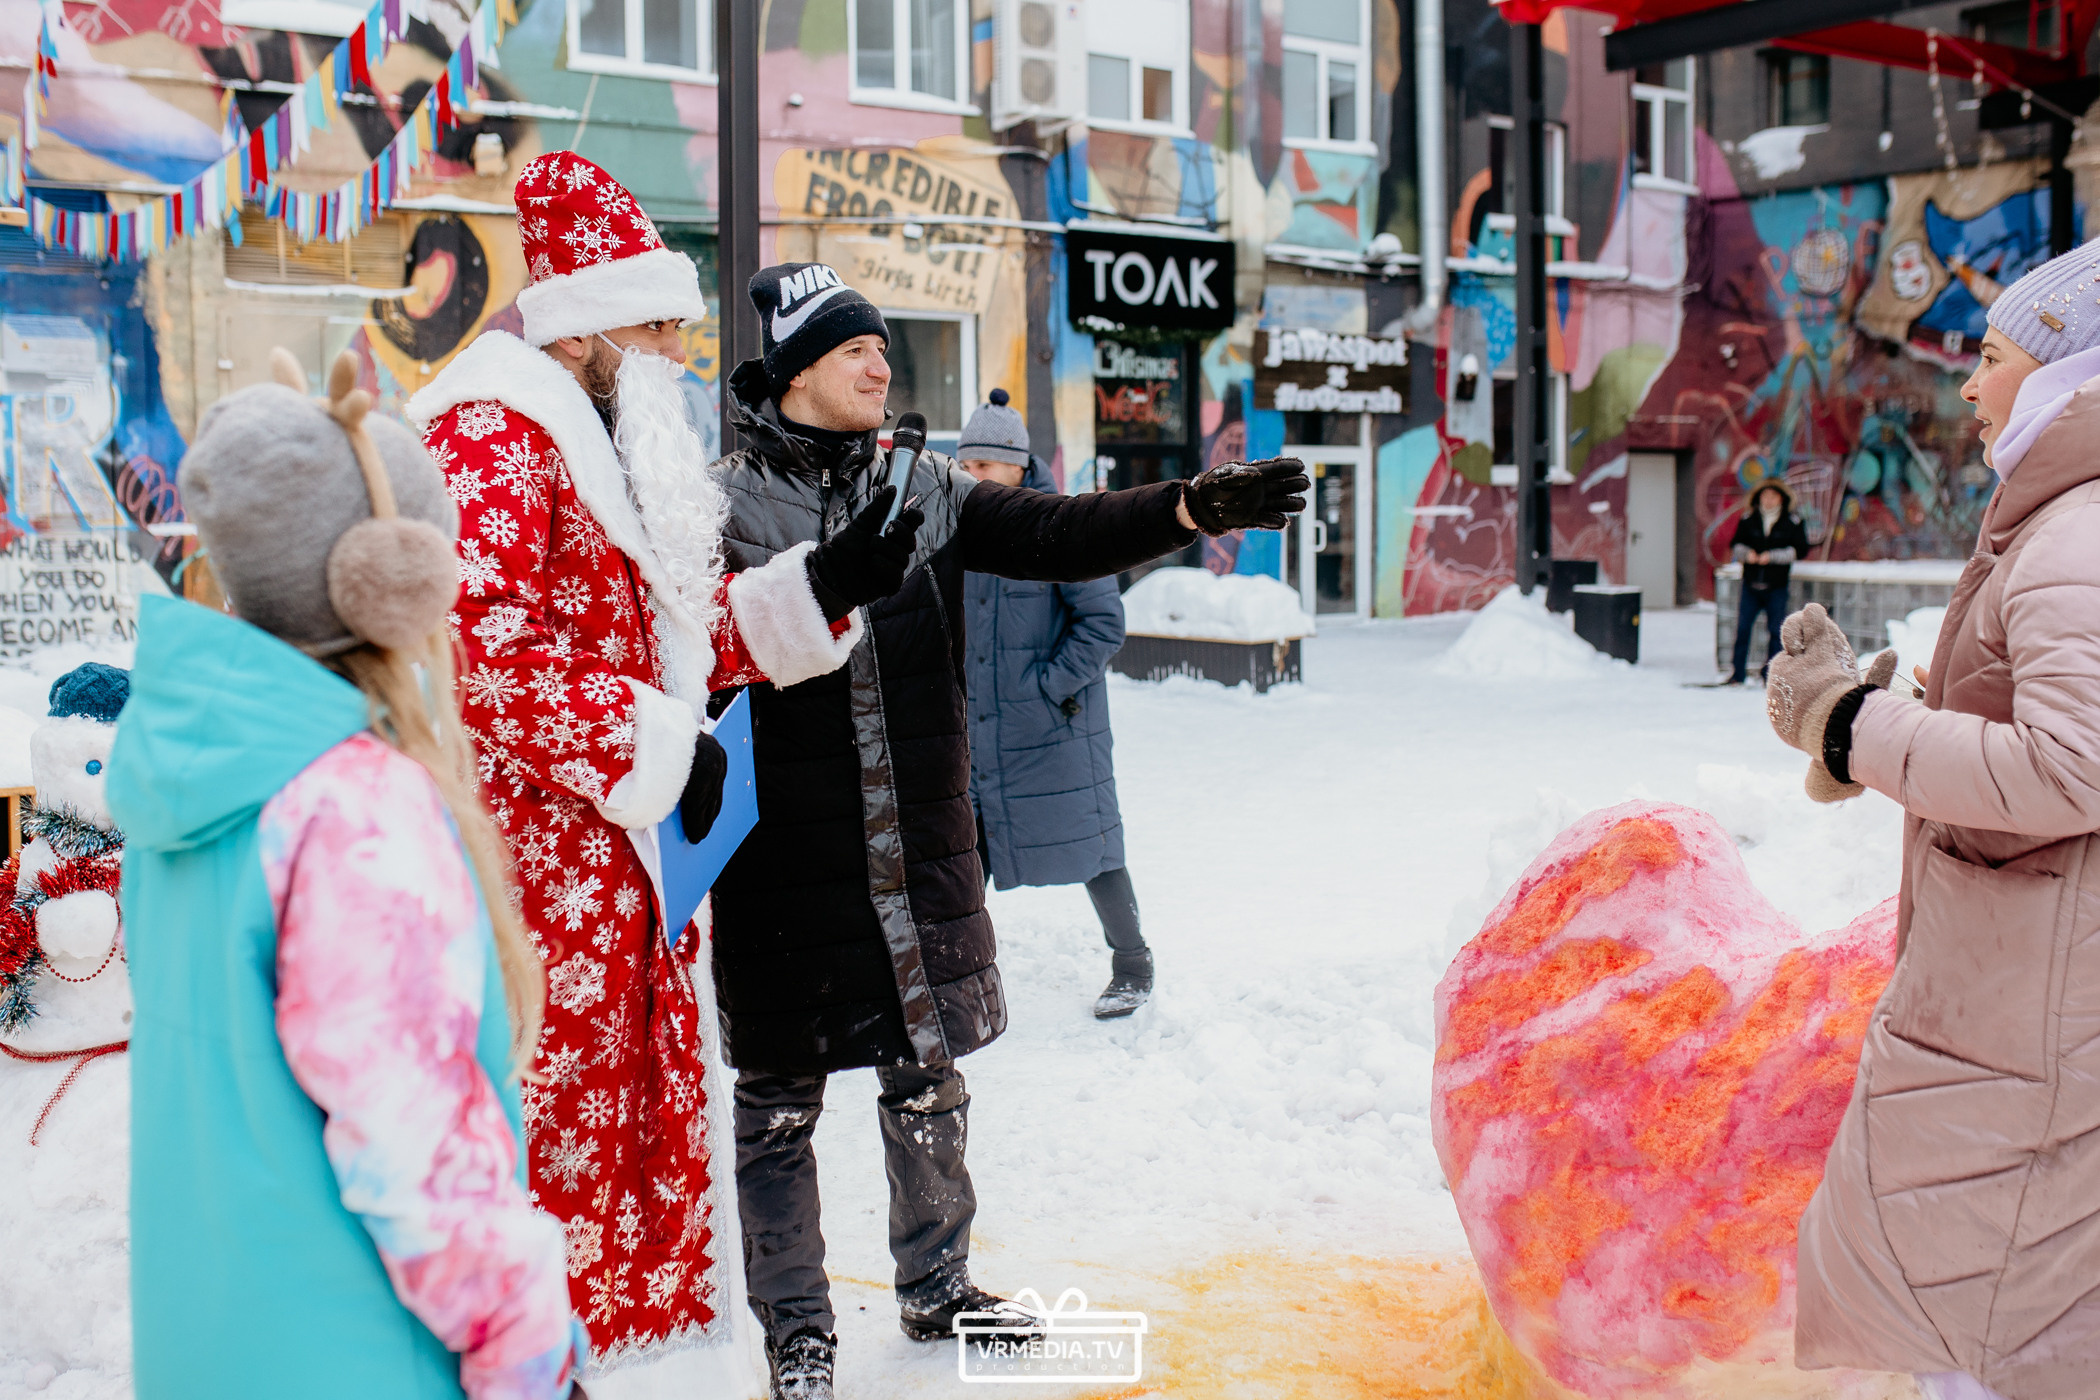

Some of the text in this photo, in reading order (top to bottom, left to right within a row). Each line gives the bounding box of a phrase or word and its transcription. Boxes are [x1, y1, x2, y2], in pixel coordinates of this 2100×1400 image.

[1085, 250, 1219, 309] TOAK
[74, 569, 105, 588] DO
[0, 592, 117, 613] HEN YOU
[0, 618, 94, 644] ECOME
